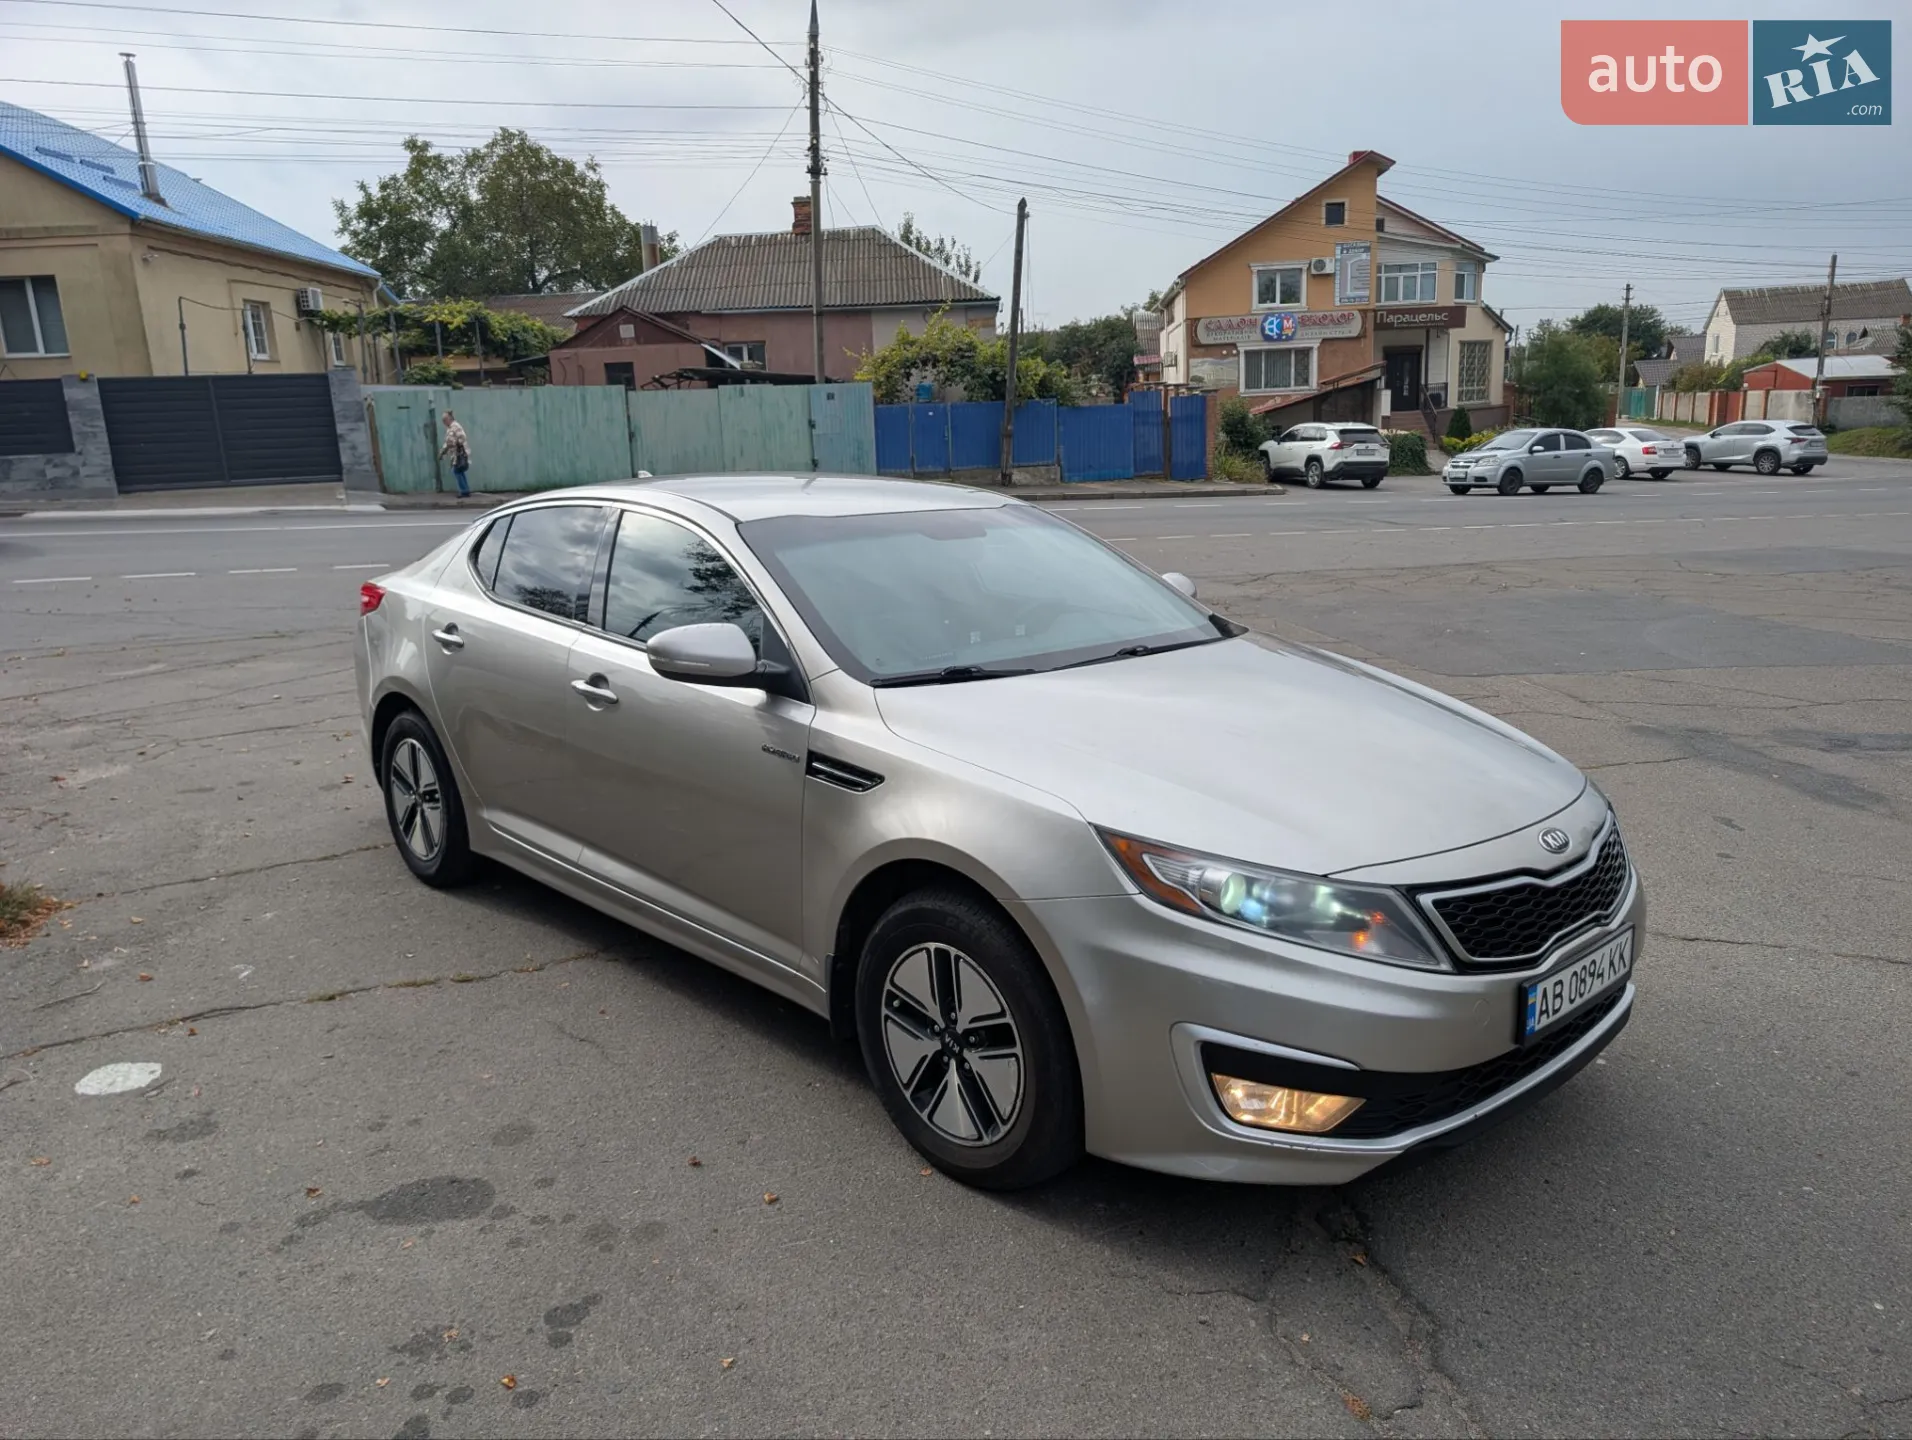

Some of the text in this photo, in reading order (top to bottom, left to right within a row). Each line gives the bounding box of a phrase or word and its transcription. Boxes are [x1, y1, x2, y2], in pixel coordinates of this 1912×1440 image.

[1376, 311, 1449, 327] Парацельс
[1537, 979, 1564, 1025] AB
[1568, 953, 1606, 1005] 0894
[1608, 936, 1629, 981] KK
